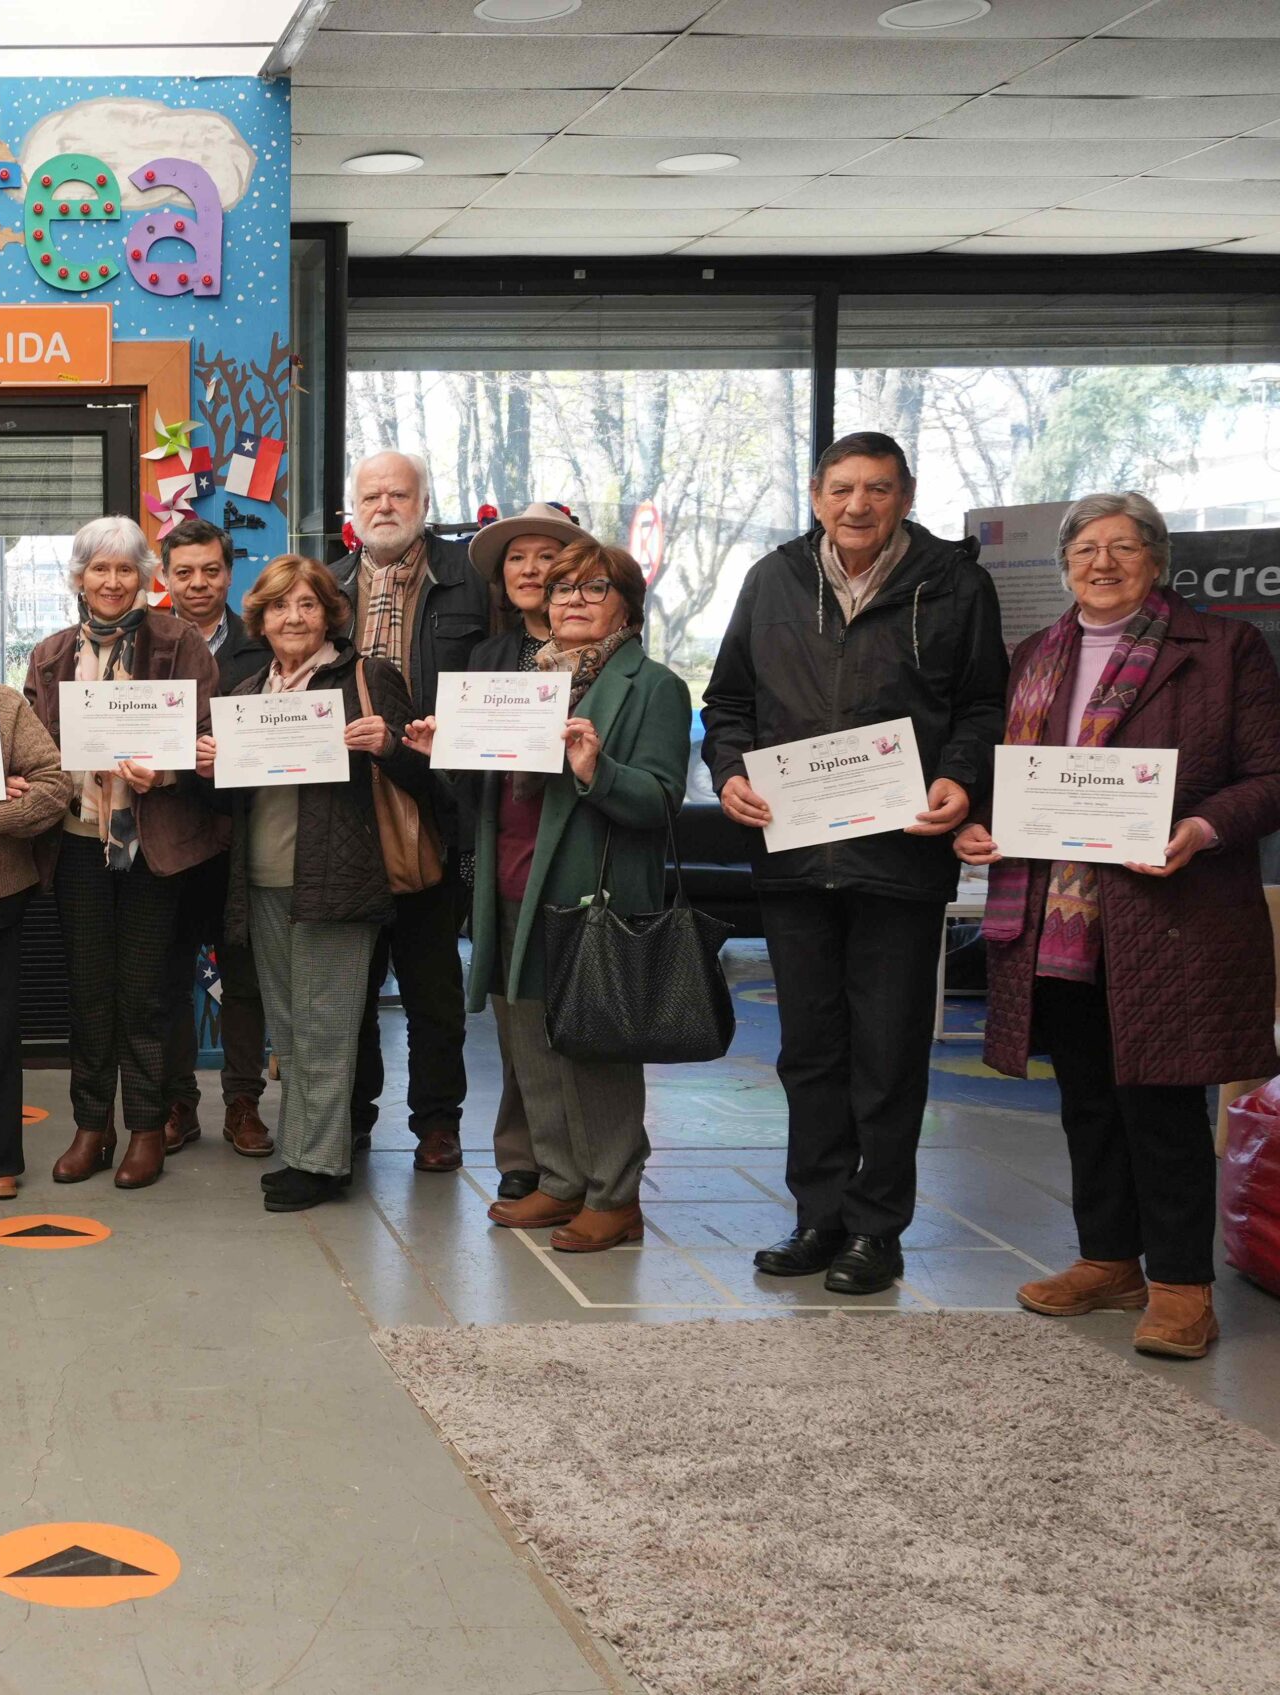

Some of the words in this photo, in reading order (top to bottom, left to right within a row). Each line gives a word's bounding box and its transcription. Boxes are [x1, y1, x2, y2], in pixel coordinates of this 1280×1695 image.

[109, 701, 158, 712] Diploma
[483, 694, 530, 707] Diploma
[260, 714, 308, 725] Diploma
[809, 753, 870, 773] Diploma
[1060, 772, 1125, 787] Diploma
